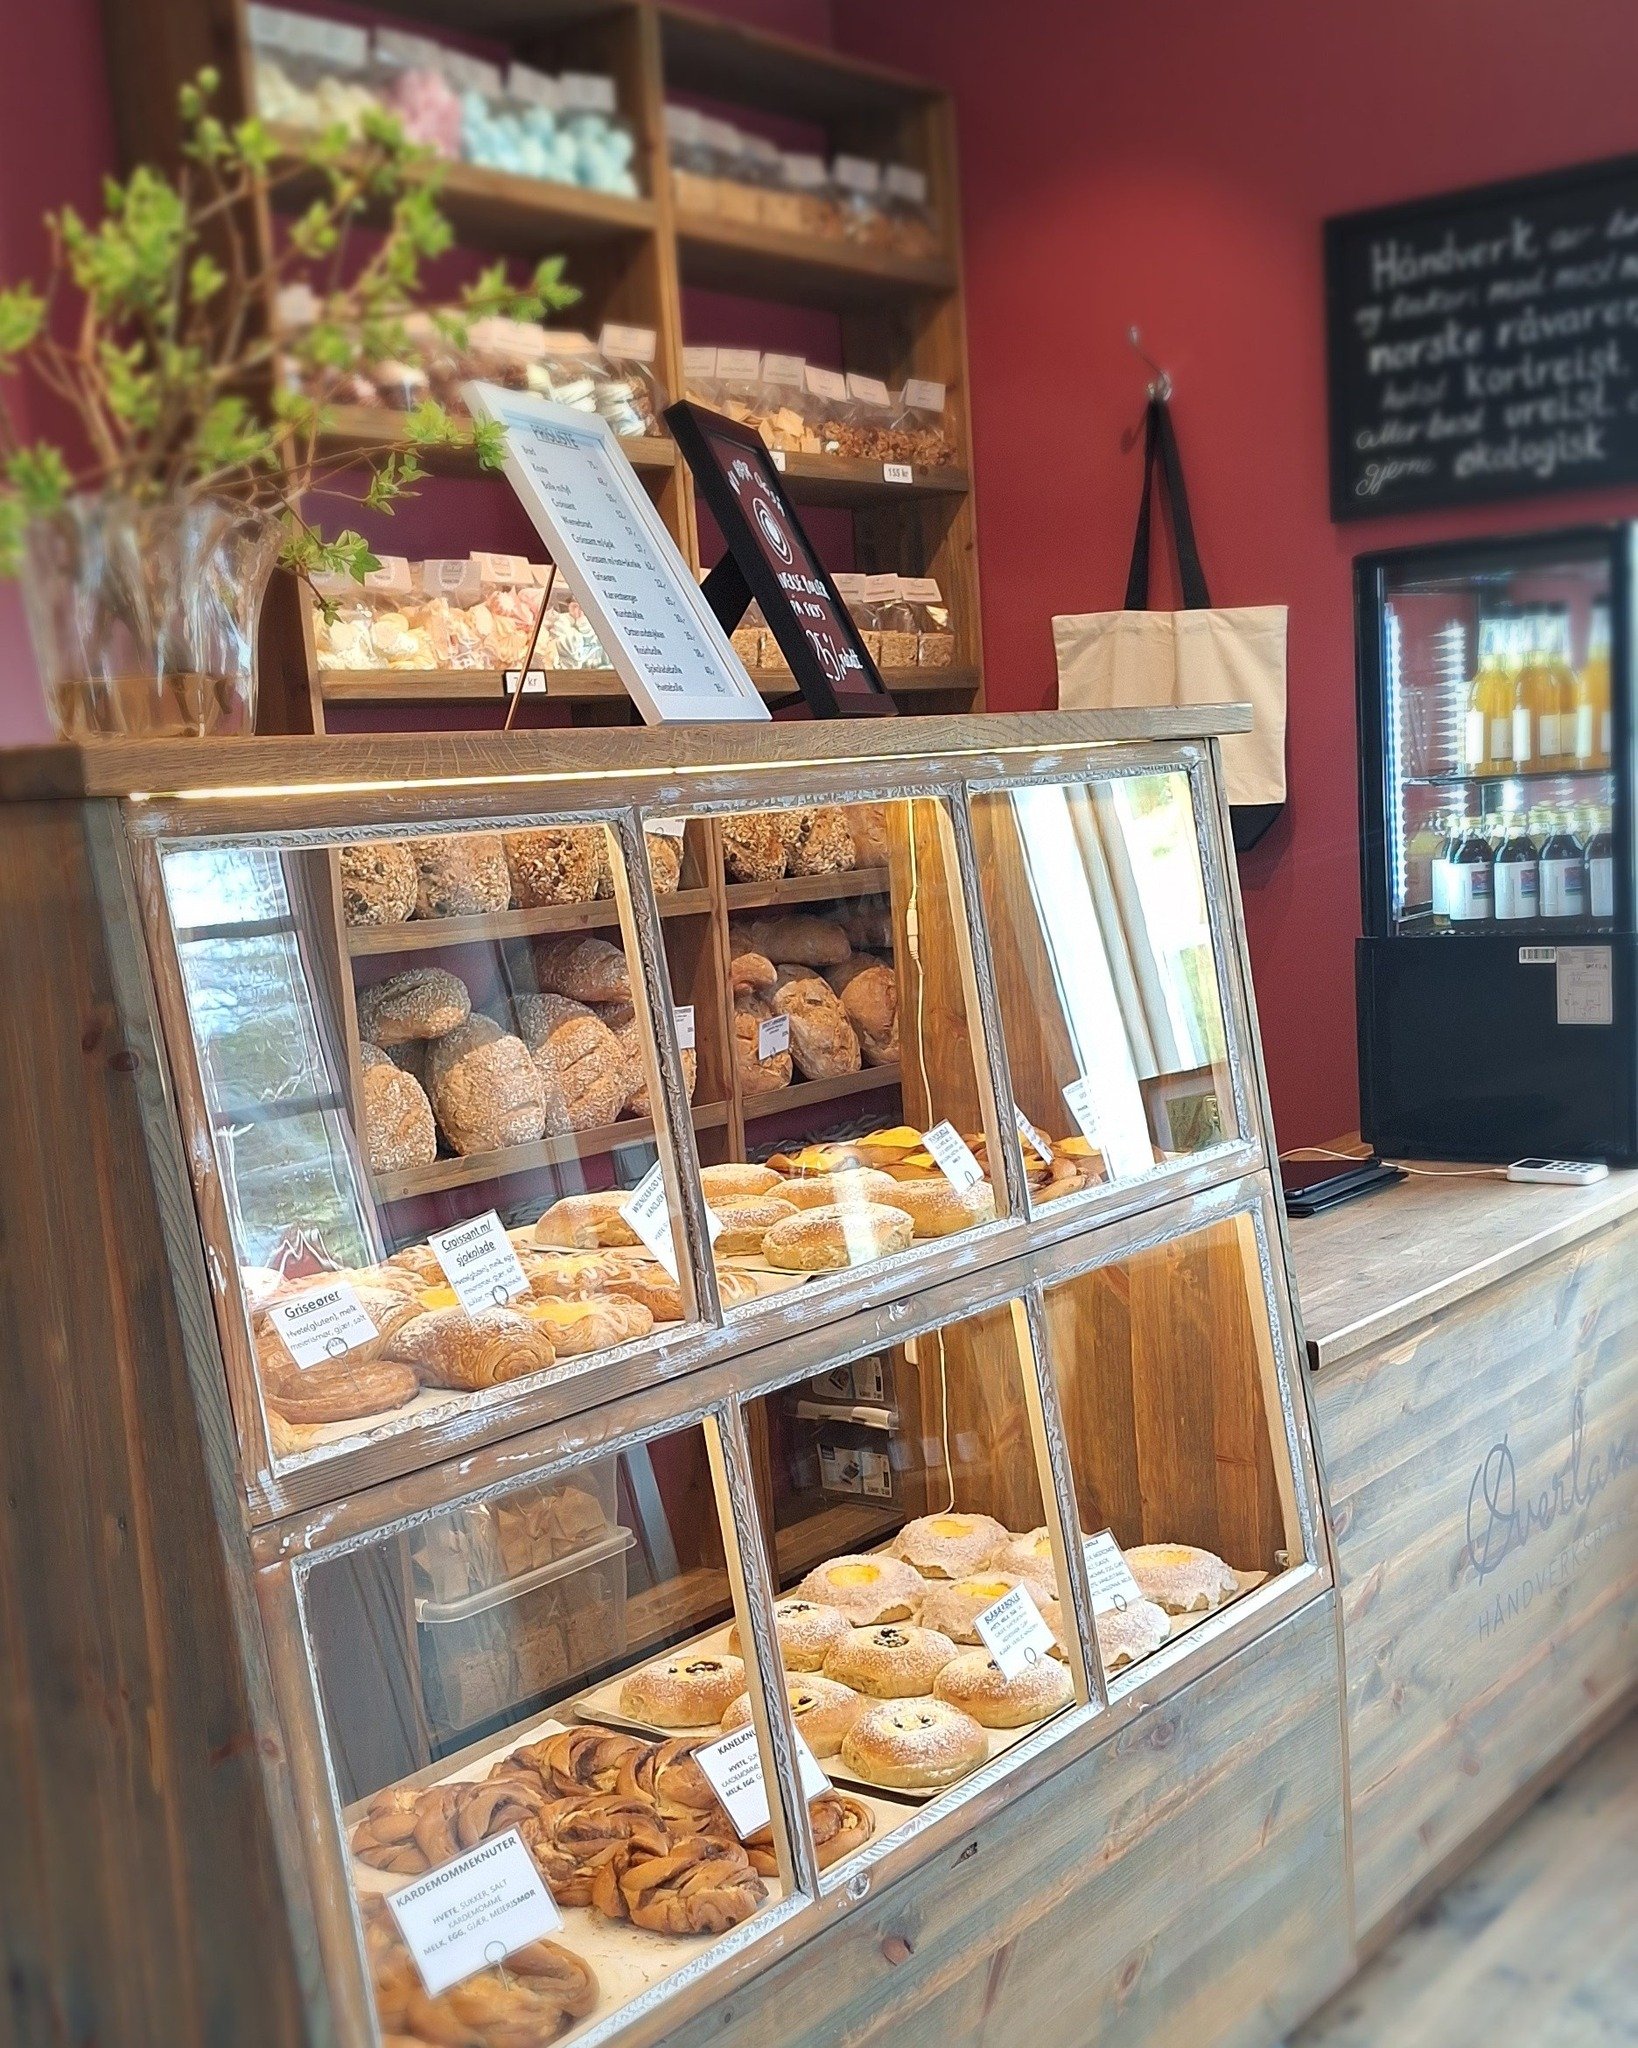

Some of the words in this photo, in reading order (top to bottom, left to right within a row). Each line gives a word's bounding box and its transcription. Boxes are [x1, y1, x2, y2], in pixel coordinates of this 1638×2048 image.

[1367, 321, 1482, 374] norske
[529, 423, 580, 450] PRISLISTE
[1355, 456, 1436, 496] gjerne
[441, 1226, 480, 1251] Croissant
[480, 1220, 492, 1234] m/
[456, 1240, 496, 1267] sjokolade
[285, 1290, 341, 1319] Griseører
[396, 1836, 517, 1908] KARDEMOMMEKNUTER
[490, 1878, 509, 1894] SALT
[448, 1895, 503, 1929] KARDEMOMME
[489, 1888, 537, 1921] MEIERISMØR
